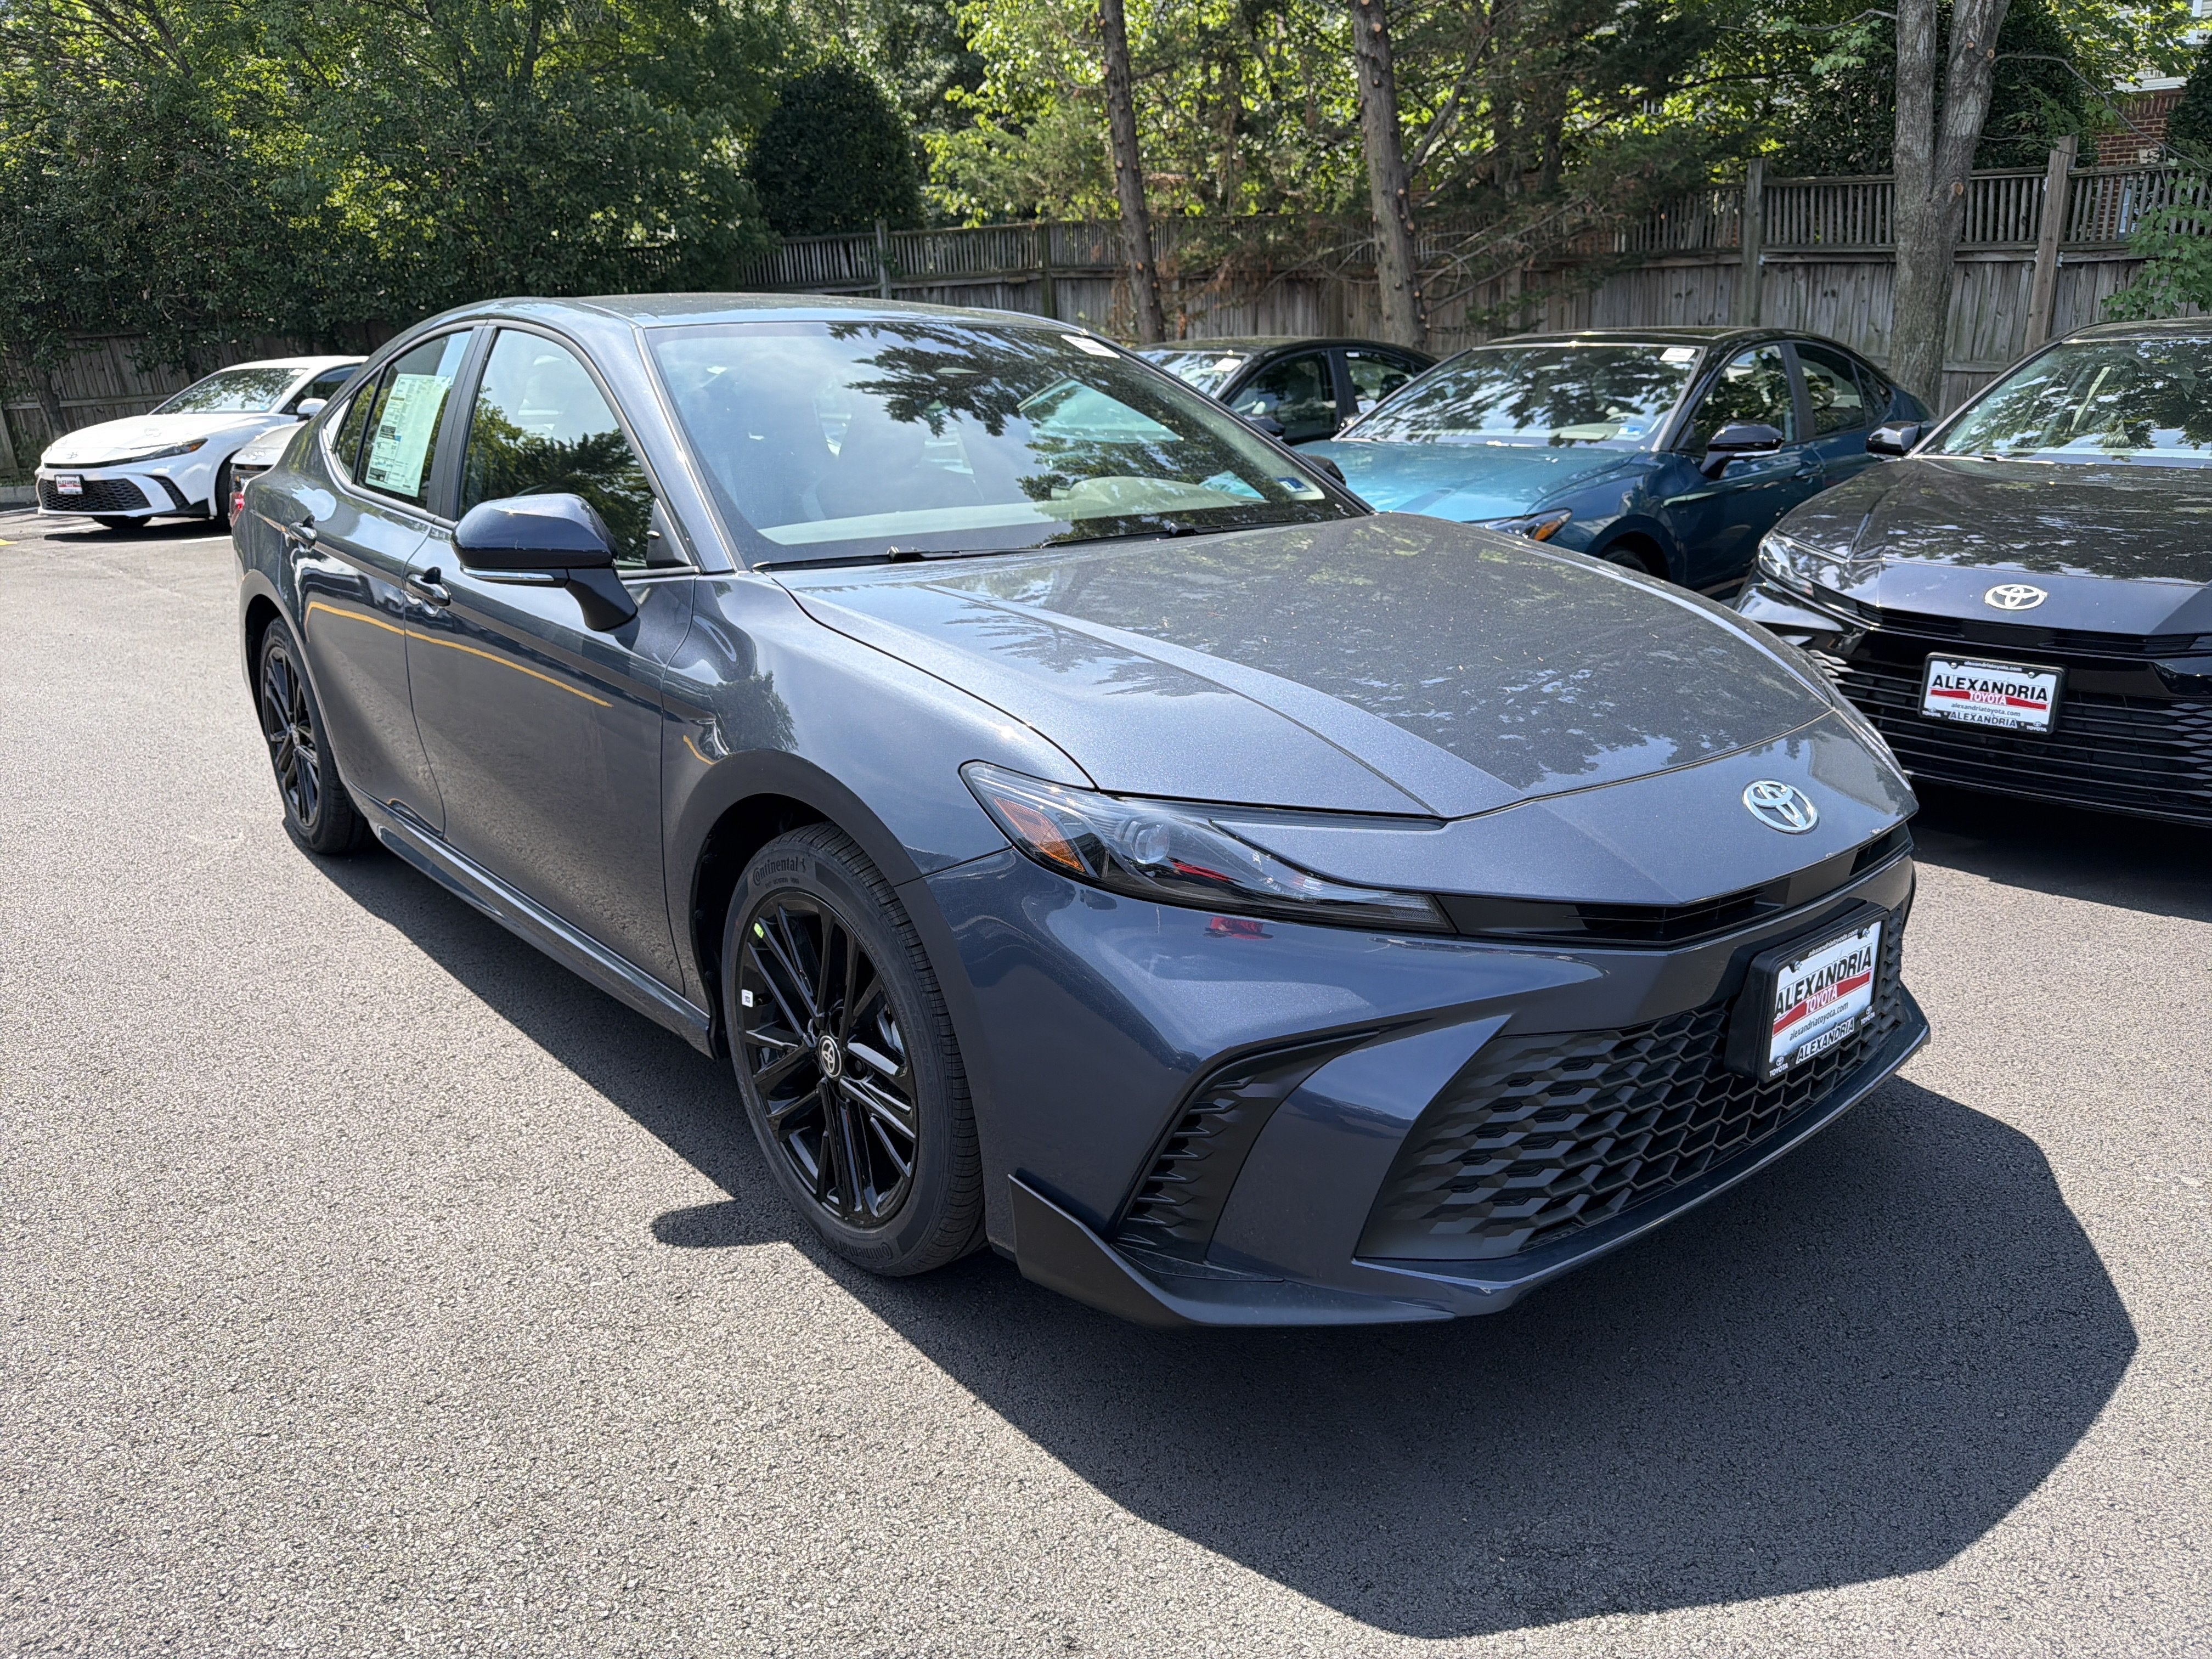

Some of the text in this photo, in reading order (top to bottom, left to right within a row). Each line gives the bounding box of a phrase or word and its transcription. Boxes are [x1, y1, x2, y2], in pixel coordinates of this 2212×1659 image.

[1932, 674, 2048, 702] ALEXANDRIA
[1970, 691, 2006, 706] TOYOTA
[1950, 711, 2016, 727] ALEXANDRIA
[1951, 702, 2021, 716] alexandriatoyota.com
[753, 856, 798, 886] Continental
[1775, 945, 1872, 1014] ALEXANDRIA
[1805, 985, 1838, 1015] TOYOTA
[1789, 1002, 1848, 1041] alexandriatoyota.com
[1861, 1012, 1875, 1026] TOYOTA
[1797, 1018, 1854, 1063] ALEXANDRIA
[1769, 1063, 1788, 1077] TOYOTA
